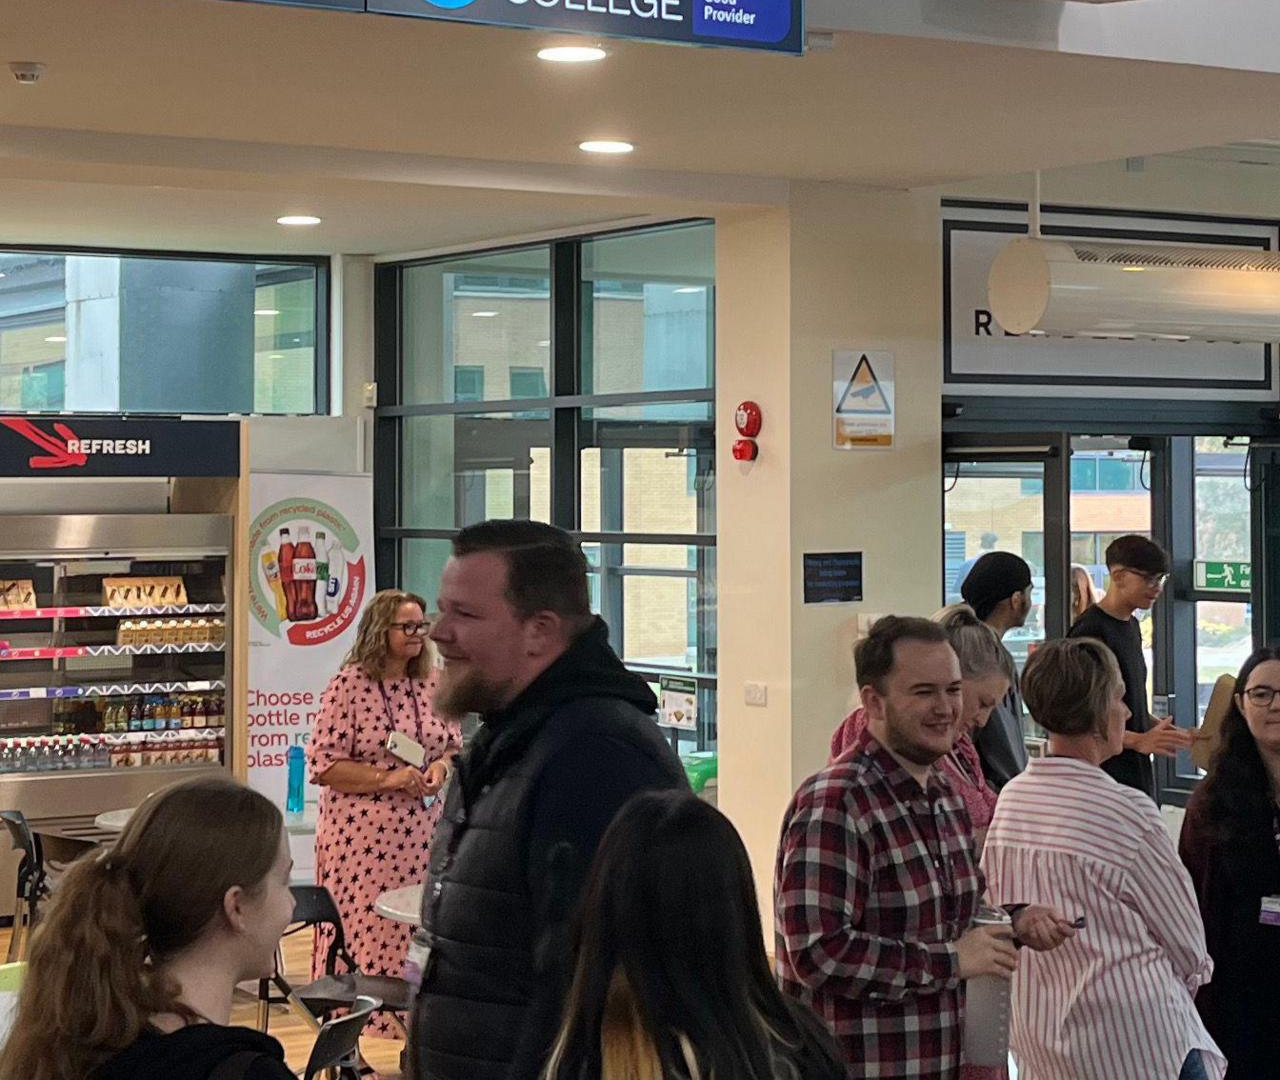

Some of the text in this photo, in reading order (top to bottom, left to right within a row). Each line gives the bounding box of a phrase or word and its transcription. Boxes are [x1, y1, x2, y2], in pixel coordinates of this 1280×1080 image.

[703, 6, 756, 26] Provider
[67, 439, 151, 455] REFRESH
[248, 731, 289, 747] rom
